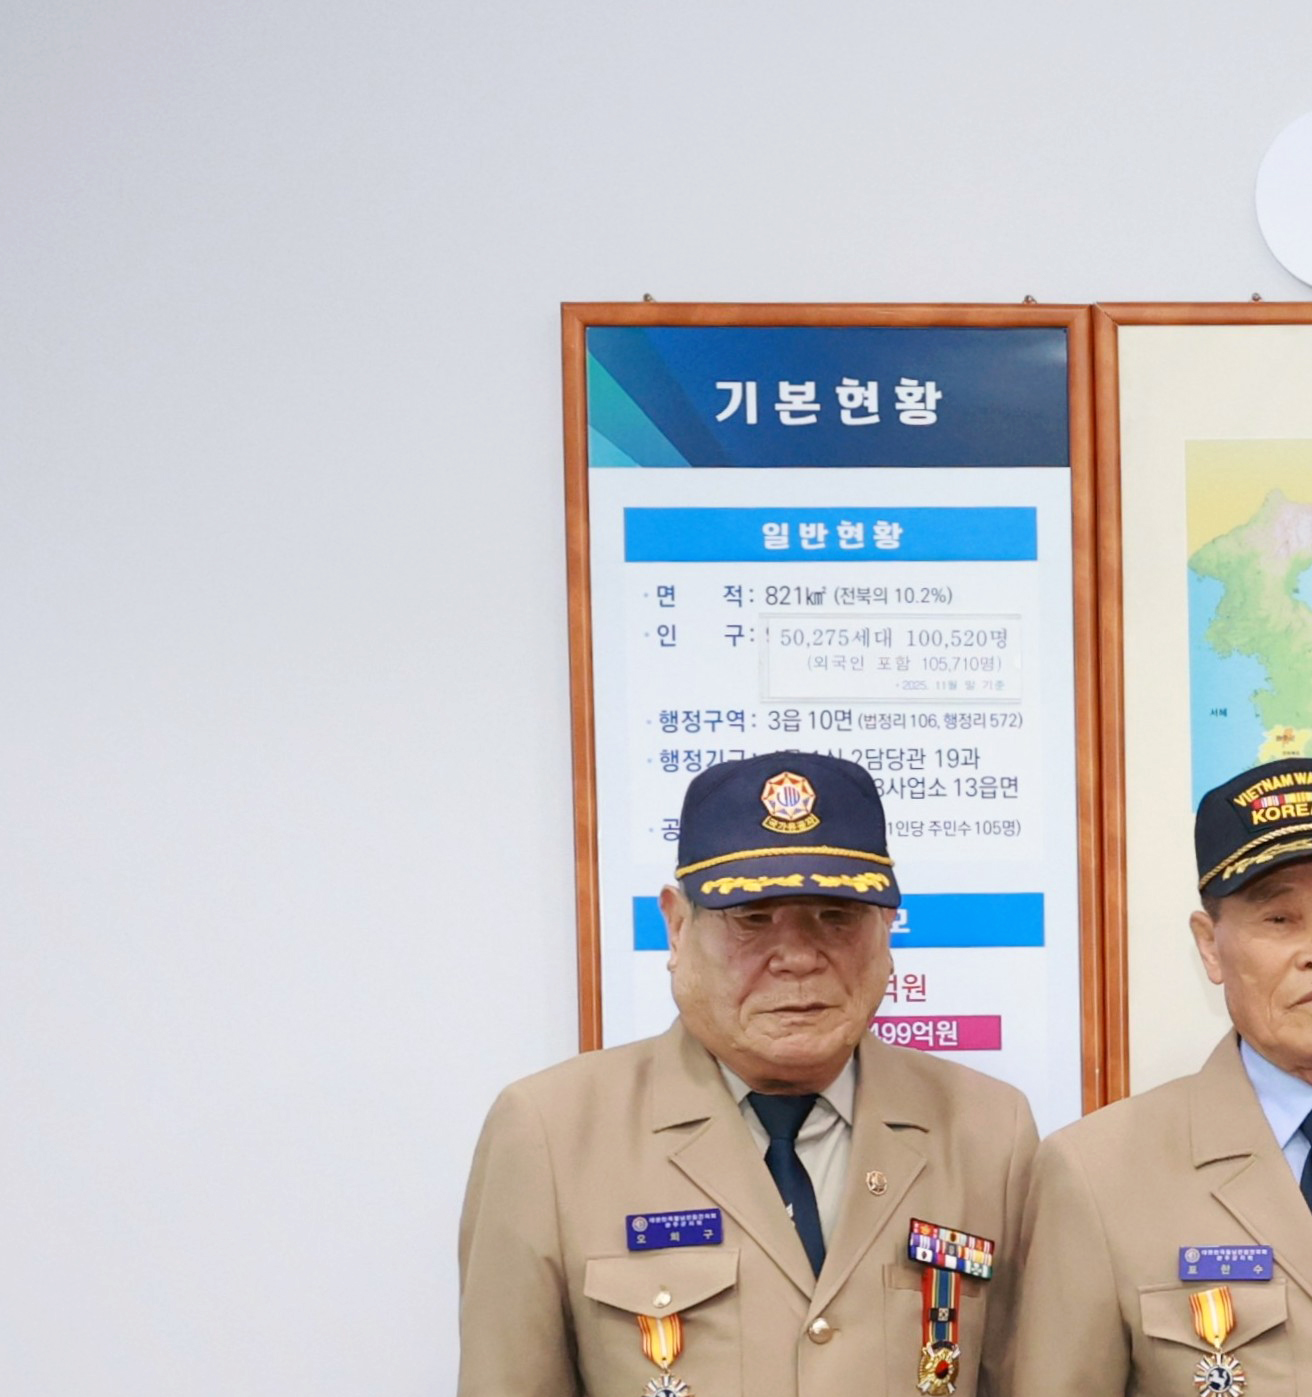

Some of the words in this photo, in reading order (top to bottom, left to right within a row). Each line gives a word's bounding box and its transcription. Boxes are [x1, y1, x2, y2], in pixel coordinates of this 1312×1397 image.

[762, 520, 904, 550] 일반현황
[834, 587, 887, 605] (전북의
[895, 586, 953, 605] 10.2%)
[781, 627, 892, 648] 50,275세대
[908, 628, 1007, 649] 100,520명
[808, 655, 864, 671] (외국인
[877, 656, 911, 671] 포함
[923, 656, 1001, 672] 105,710명)
[768, 709, 802, 732] 3읍
[809, 709, 852, 731] 10면
[858, 713, 906, 730] (법정리
[910, 713, 940, 729] 106,
[944, 713, 986, 730] 행정리
[990, 712, 1023, 728] 572)
[935, 747, 980, 770] 19과
[954, 776, 1018, 799] 13읍면
[1233, 774, 1296, 808] VIETNAM
[928, 820, 971, 837] 주민수
[975, 820, 1021, 837] 105명)
